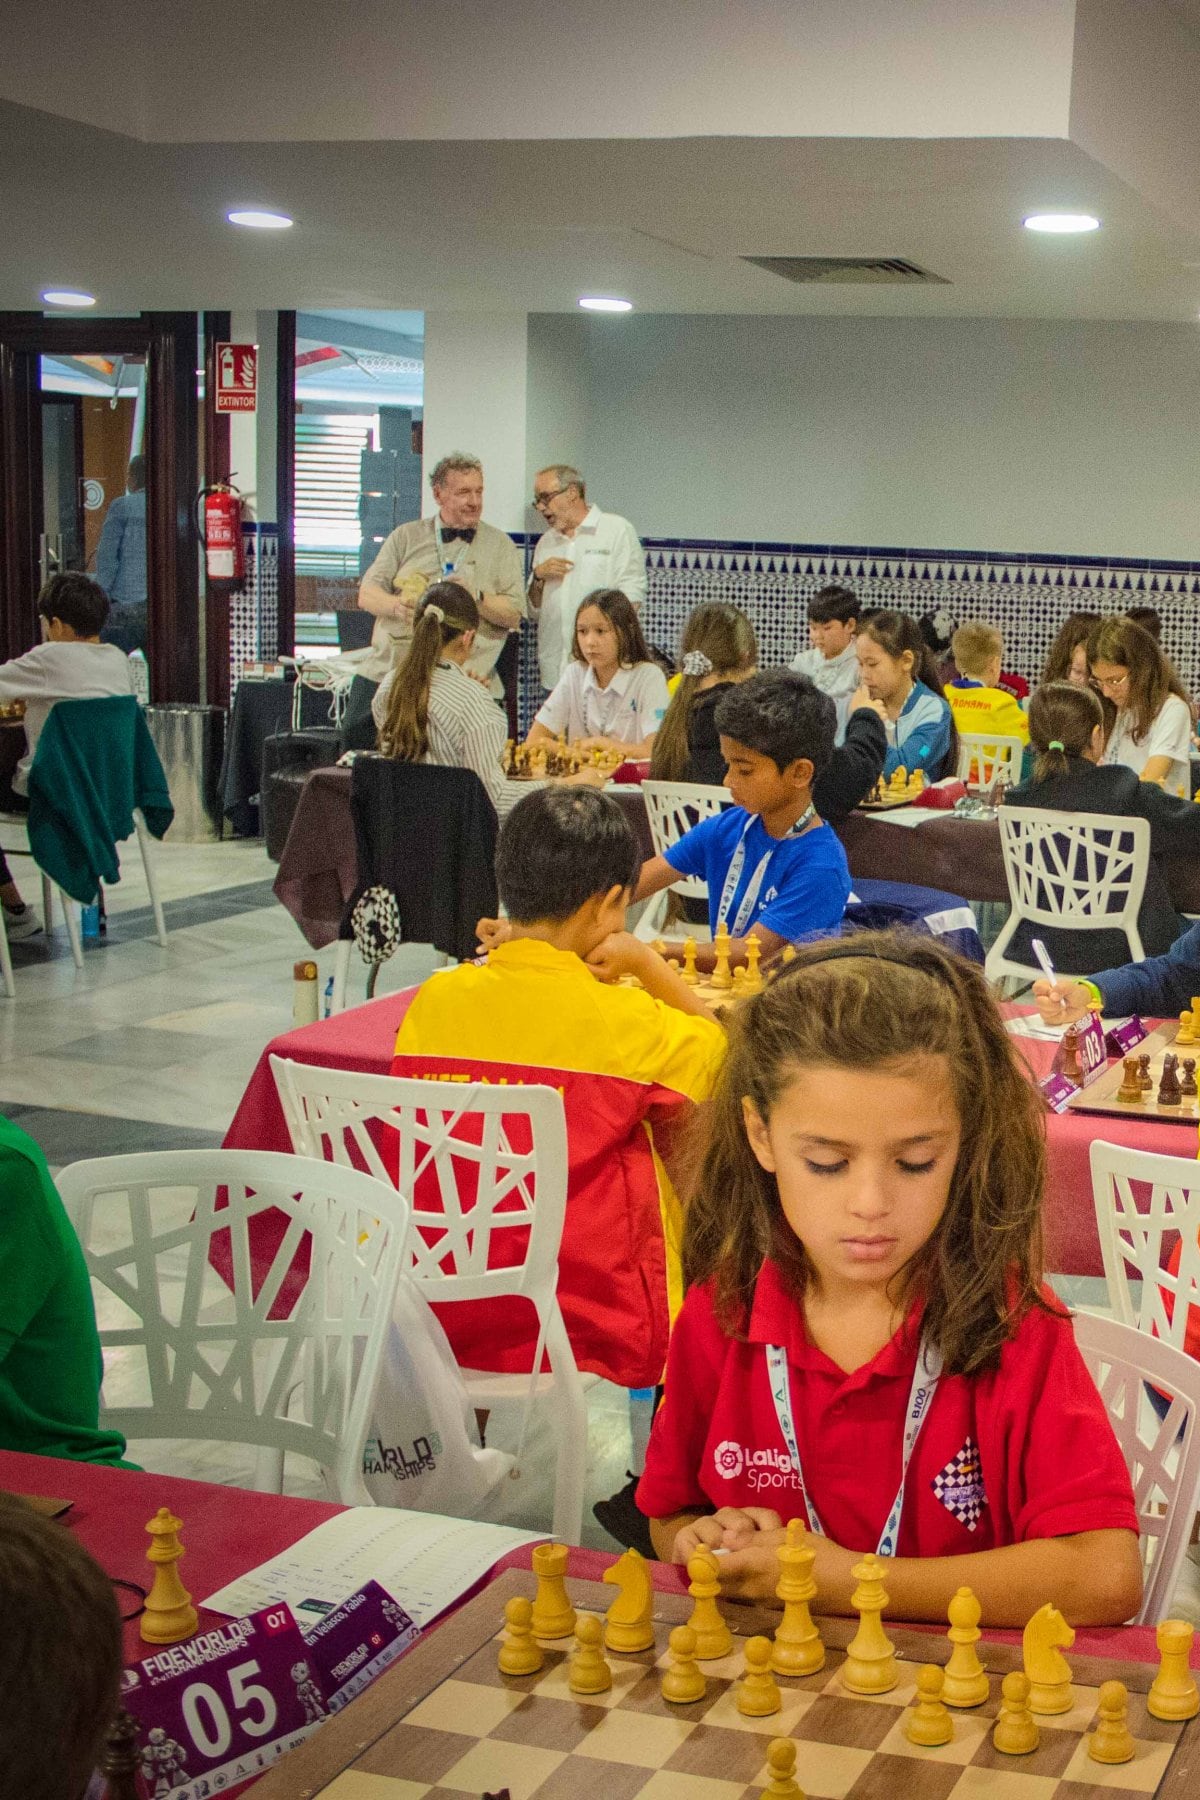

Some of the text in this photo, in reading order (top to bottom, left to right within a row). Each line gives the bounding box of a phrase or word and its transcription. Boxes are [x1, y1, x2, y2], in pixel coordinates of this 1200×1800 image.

[219, 396, 255, 407] EXTINTOR
[1085, 1030, 1101, 1068] 03
[911, 1387, 927, 1419] B100
[745, 1448, 794, 1473] LaLig
[267, 1610, 286, 1629] 07
[314, 1610, 349, 1637] Velasco,
[344, 1593, 367, 1613] Fabio
[181, 1658, 278, 1758] 05
